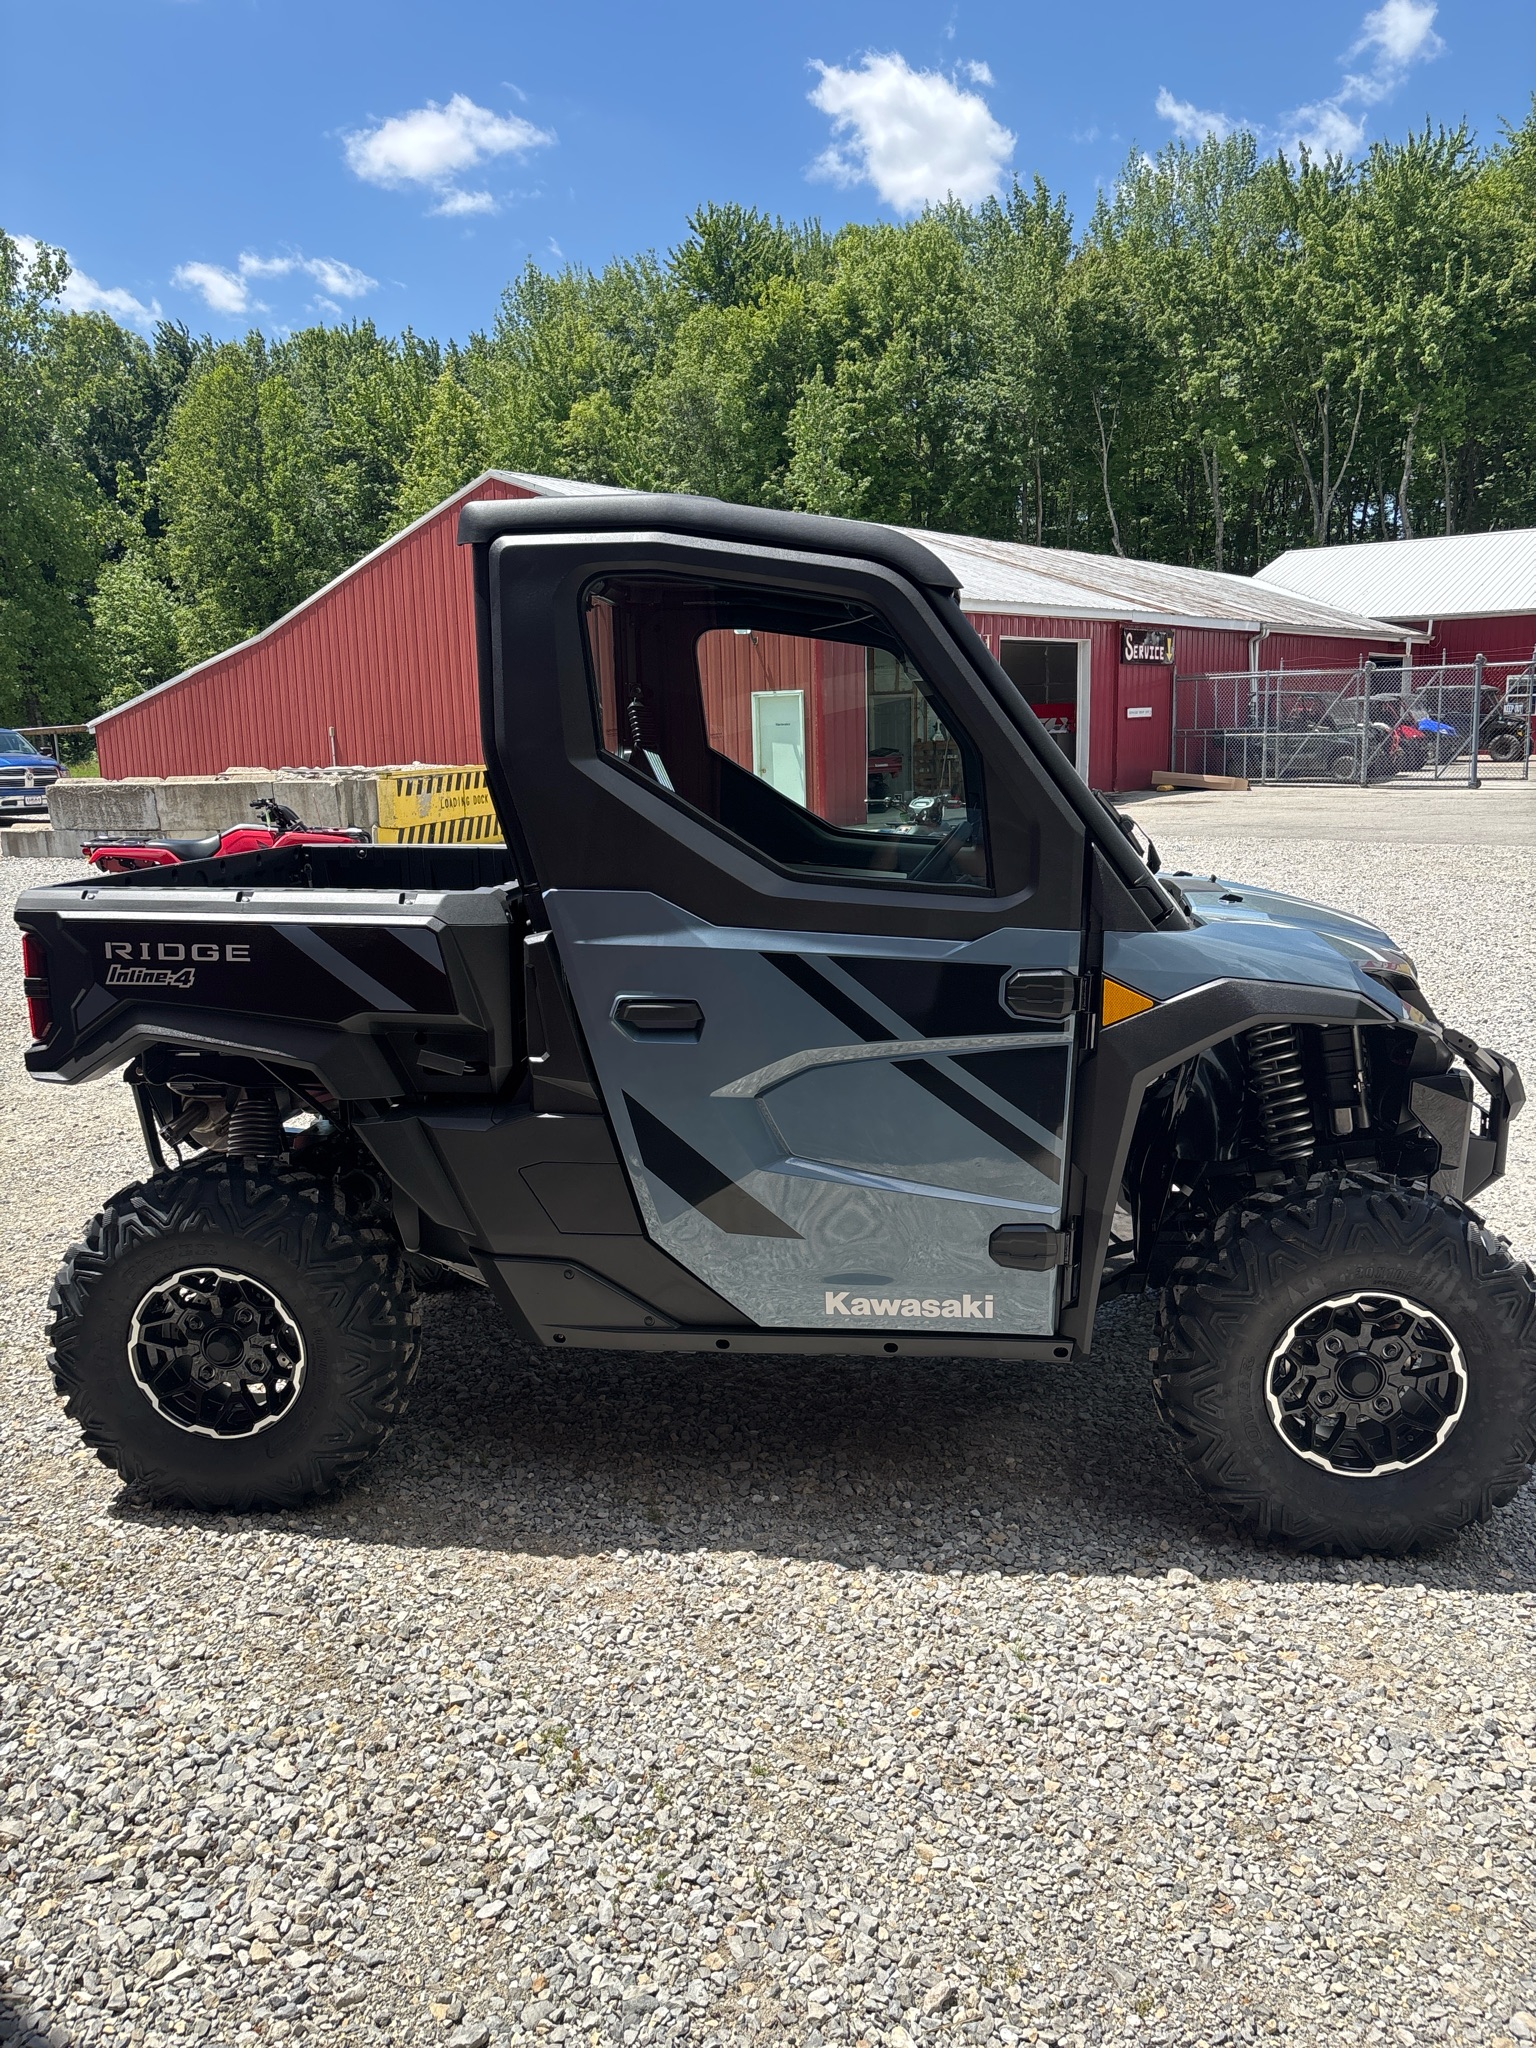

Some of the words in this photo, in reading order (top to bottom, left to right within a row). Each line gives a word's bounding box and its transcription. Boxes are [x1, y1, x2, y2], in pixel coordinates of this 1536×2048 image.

[1125, 632, 1165, 661] SERVICE
[440, 796, 470, 809] LOADING
[472, 793, 489, 805] DOCK
[105, 942, 251, 962] RIDGE
[105, 964, 196, 988] Inline-4
[825, 1291, 994, 1318] Kawasaki
